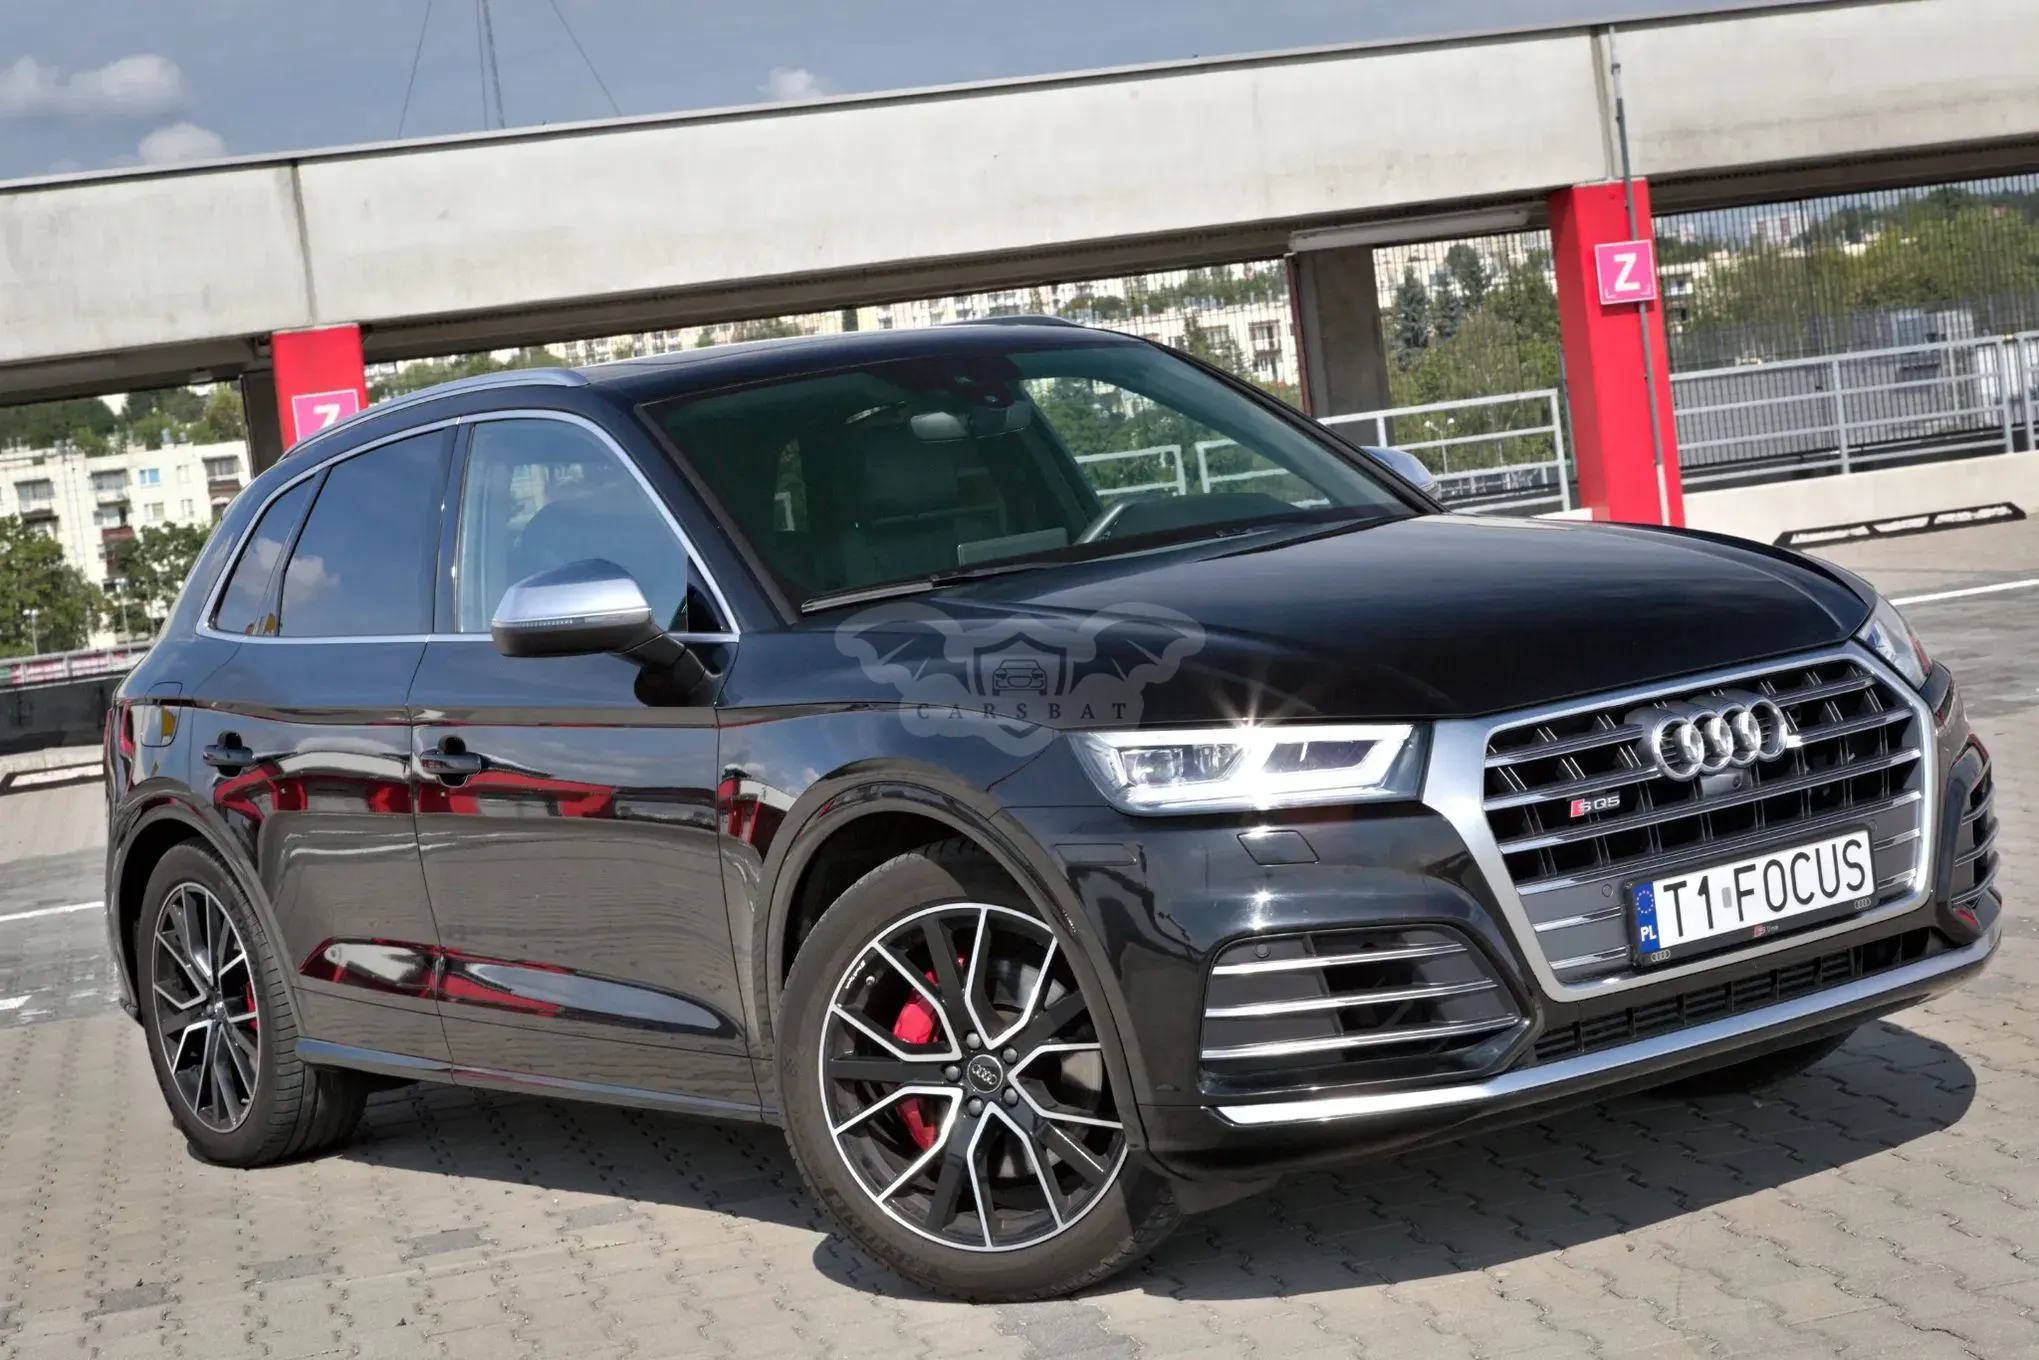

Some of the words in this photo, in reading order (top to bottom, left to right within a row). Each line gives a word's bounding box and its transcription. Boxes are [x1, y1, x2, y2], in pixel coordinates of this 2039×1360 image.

[1613, 252, 1641, 292] Z
[1733, 838, 1866, 922] FOCUS
[1640, 925, 1657, 942] PL
